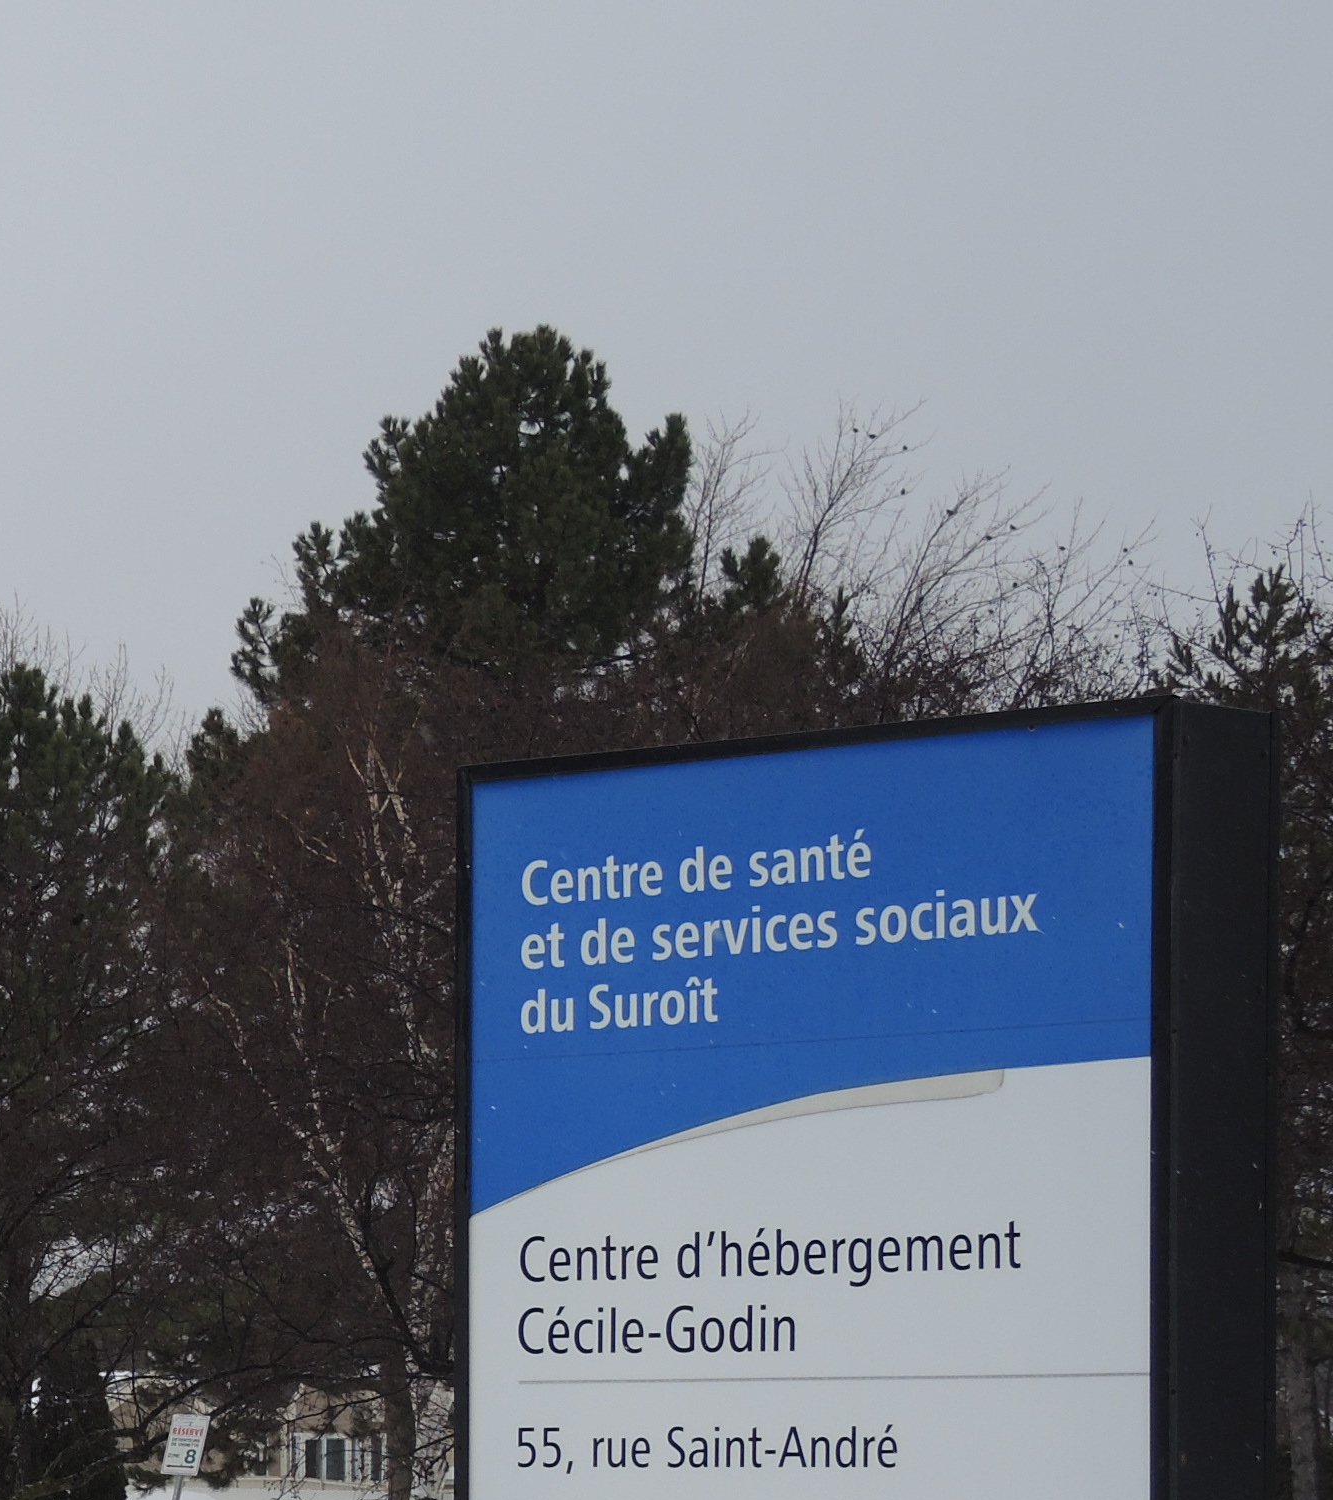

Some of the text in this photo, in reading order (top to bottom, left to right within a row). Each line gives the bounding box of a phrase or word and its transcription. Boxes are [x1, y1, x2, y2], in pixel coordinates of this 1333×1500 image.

[522, 829, 871, 905] Centre de santé
[521, 890, 1038, 969] et de services sociaux
[521, 977, 718, 1033] du Suroît
[520, 1221, 1020, 1287] Centre d'hébergement
[519, 1305, 795, 1354] Cécile-Godin
[184, 1449, 197, 1464] 8
[518, 1425, 897, 1474] 55, rue Saint-André
